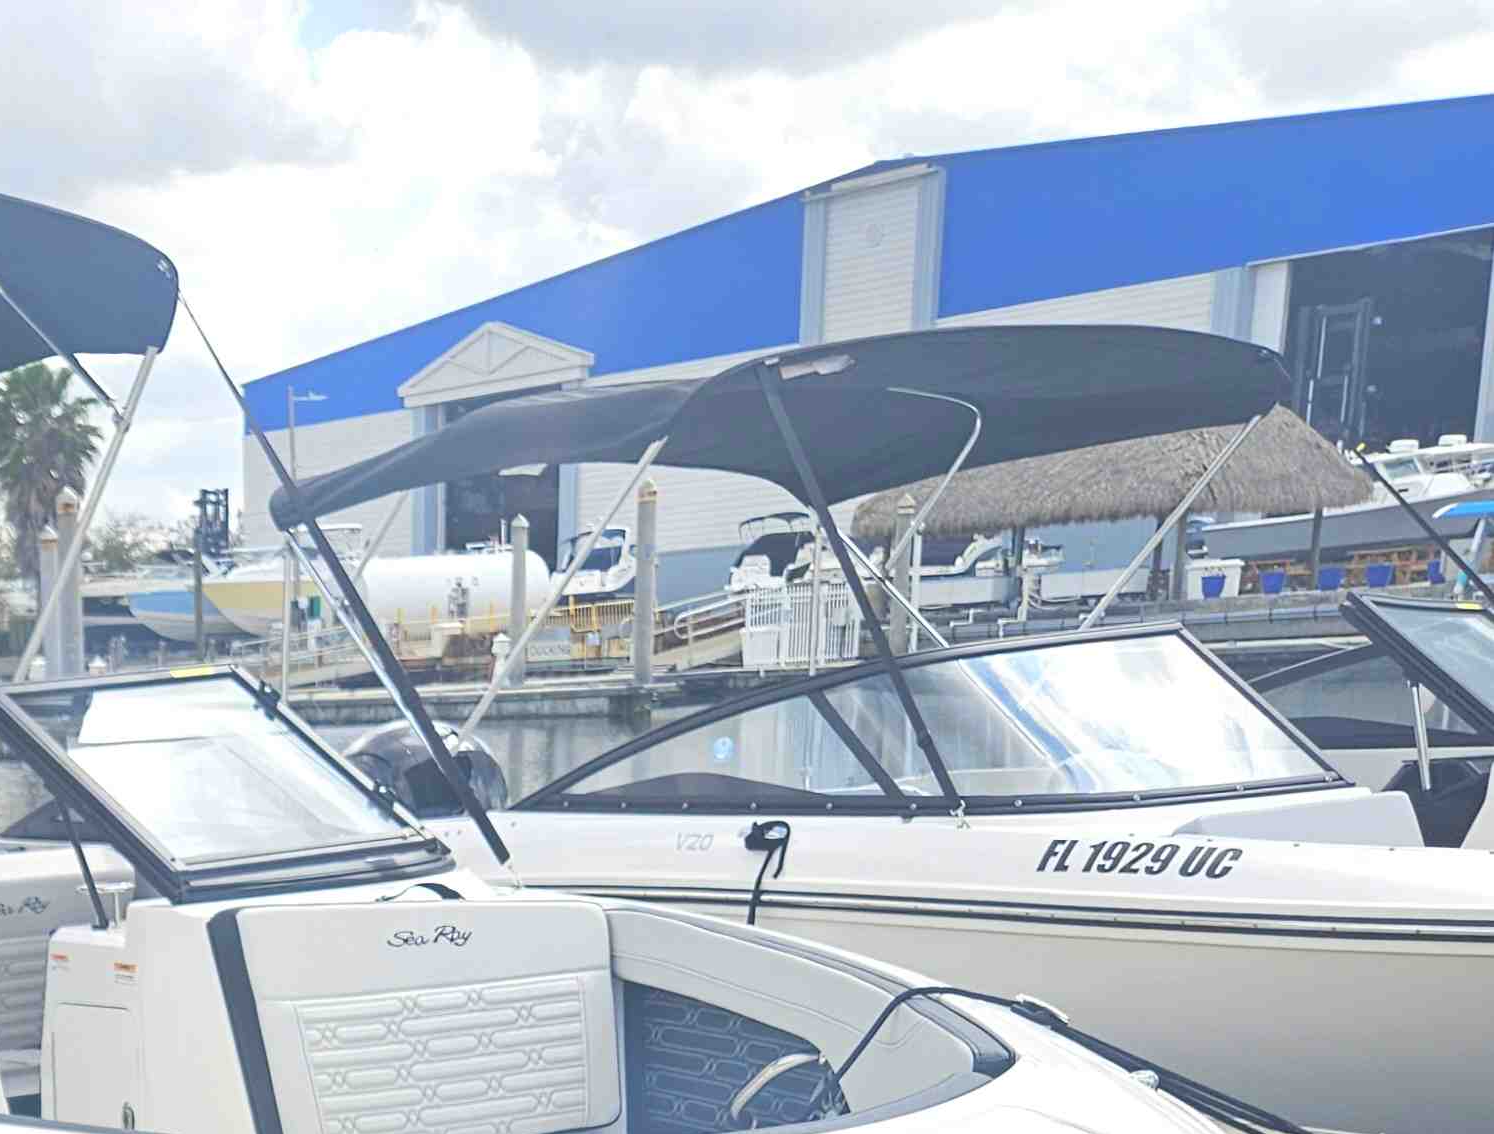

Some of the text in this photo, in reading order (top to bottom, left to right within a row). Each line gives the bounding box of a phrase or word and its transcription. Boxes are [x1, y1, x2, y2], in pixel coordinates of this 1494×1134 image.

[1037, 839, 1243, 879] FL 1929 UC
[387, 925, 472, 947] Sea Ray
